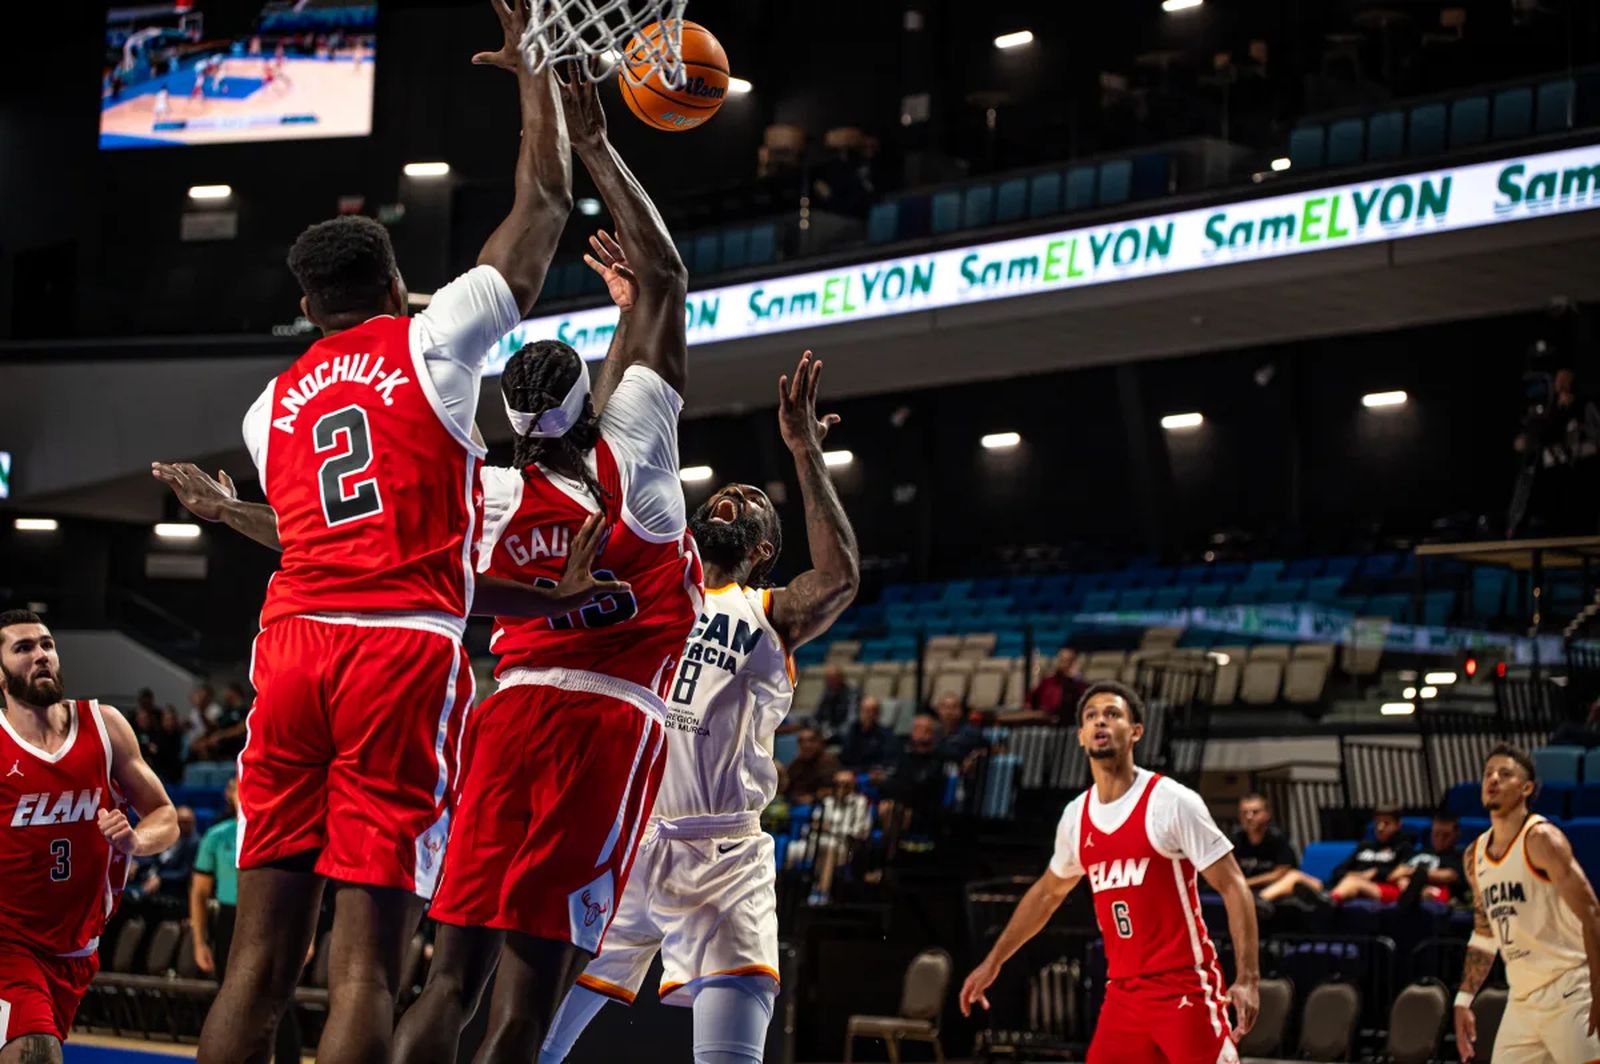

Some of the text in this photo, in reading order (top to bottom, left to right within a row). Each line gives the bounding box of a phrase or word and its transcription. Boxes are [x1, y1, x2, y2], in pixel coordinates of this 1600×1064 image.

[748, 261, 935, 320] SamELYON
[958, 222, 1174, 288] SamELYON
[1203, 176, 1453, 255] SamELYON
[272, 353, 410, 434] ANOCHILI-K.
[312, 404, 384, 527] 2
[683, 641, 737, 676] RCIA
[665, 719, 676, 729] DE
[10, 787, 103, 828] ELAN
[49, 838, 72, 882] 3
[1088, 857, 1150, 894] ELAN
[1111, 900, 1134, 939] 6
